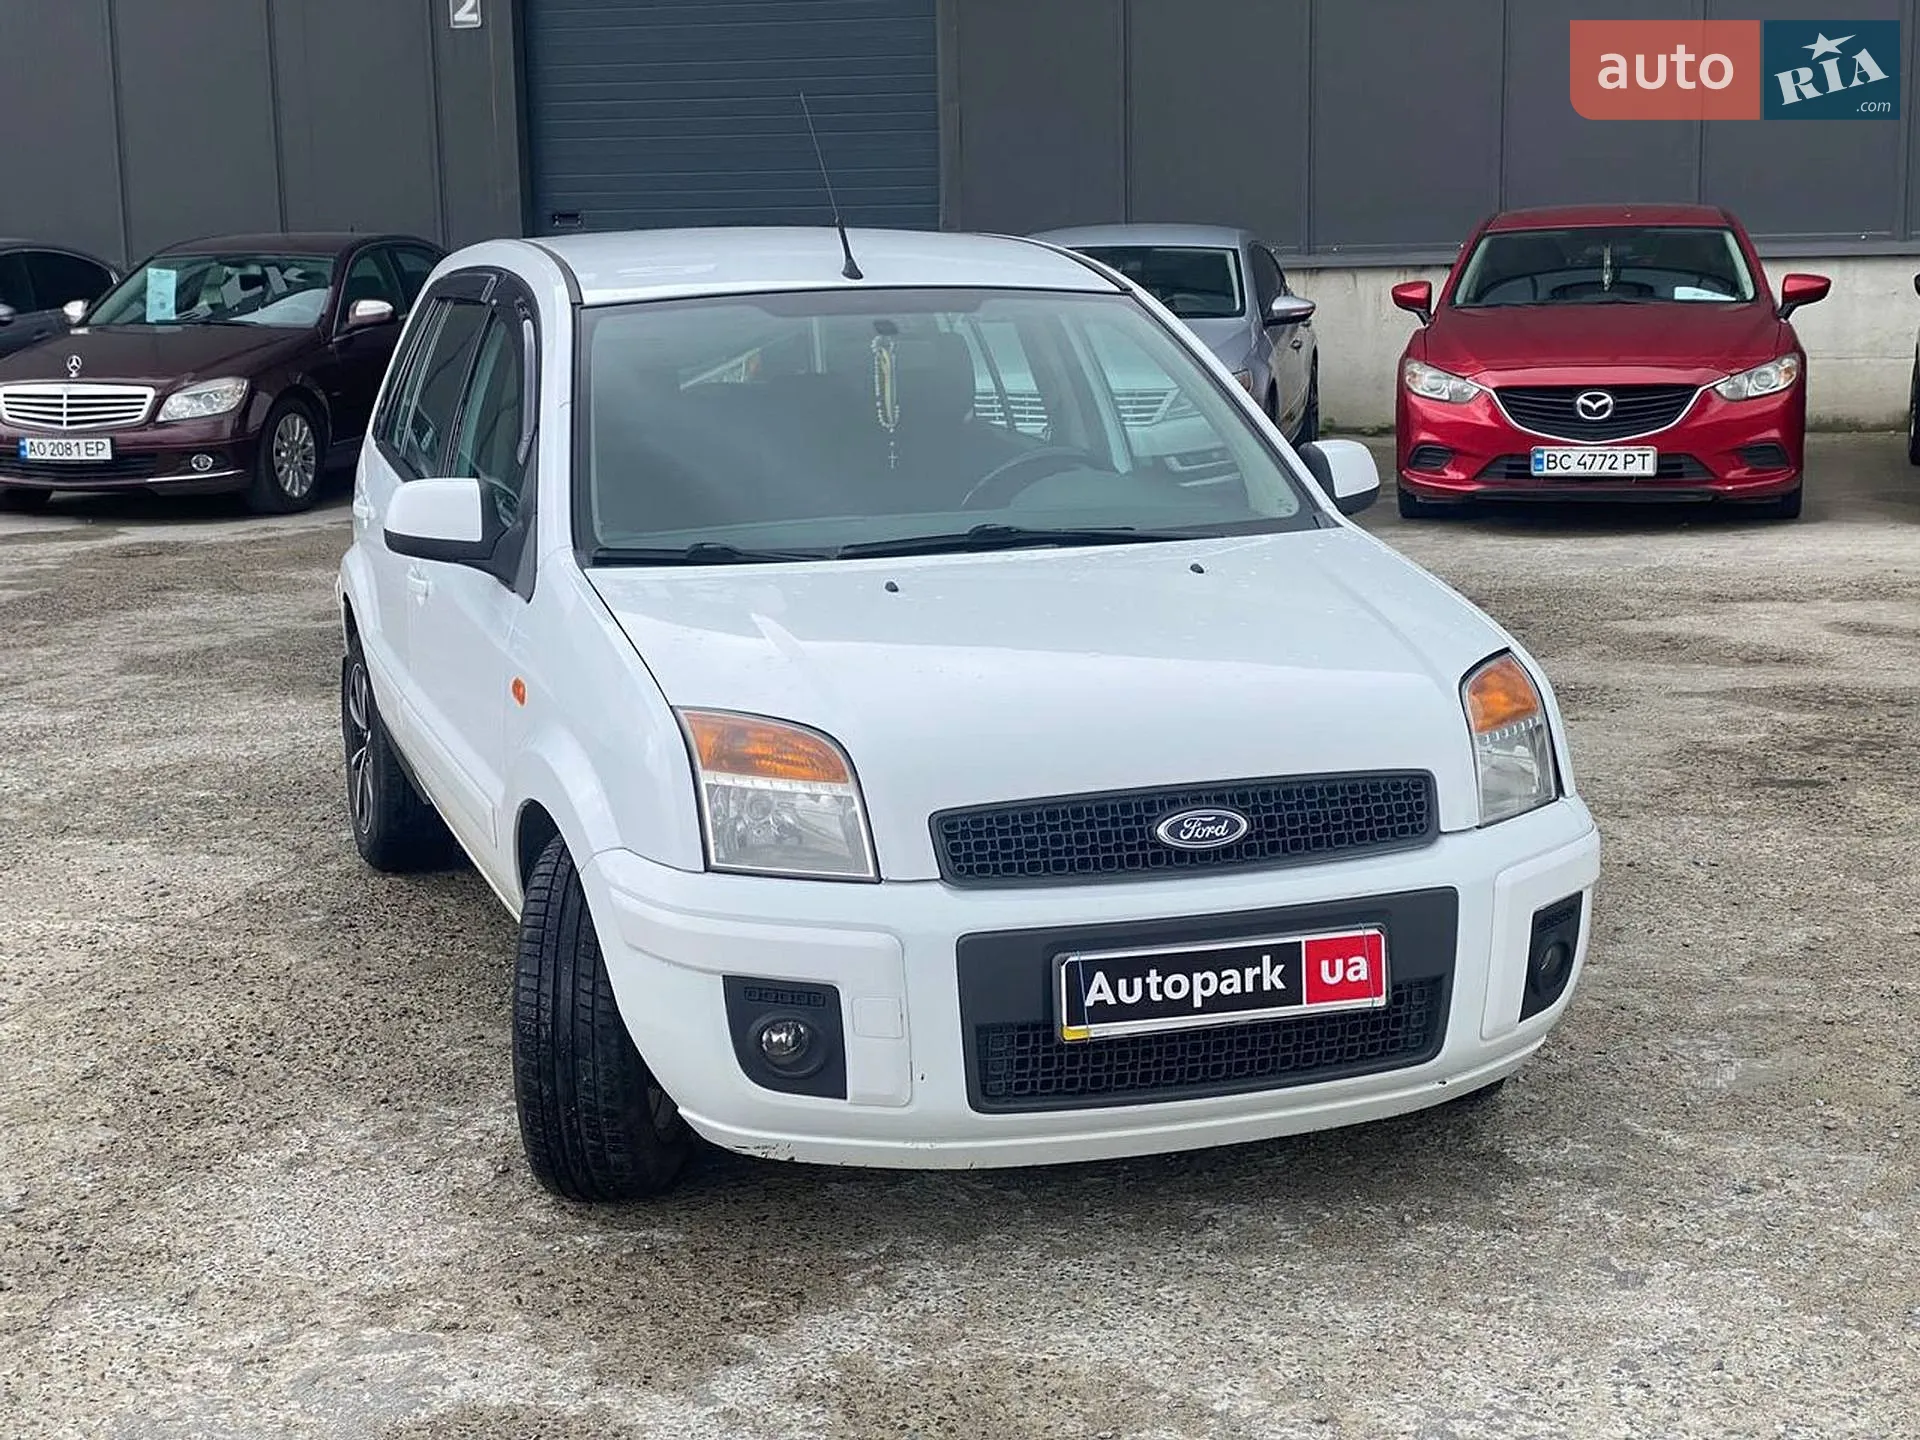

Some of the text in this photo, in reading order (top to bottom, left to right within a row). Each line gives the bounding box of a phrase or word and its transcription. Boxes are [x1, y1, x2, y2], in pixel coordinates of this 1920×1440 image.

[454, 0, 477, 21] 2
[29, 441, 106, 457] AO 2081 EP
[1546, 453, 1650, 470] BC 4772 PT
[1180, 816, 1229, 839] Ford
[1085, 955, 1369, 1008] Autopark ua
